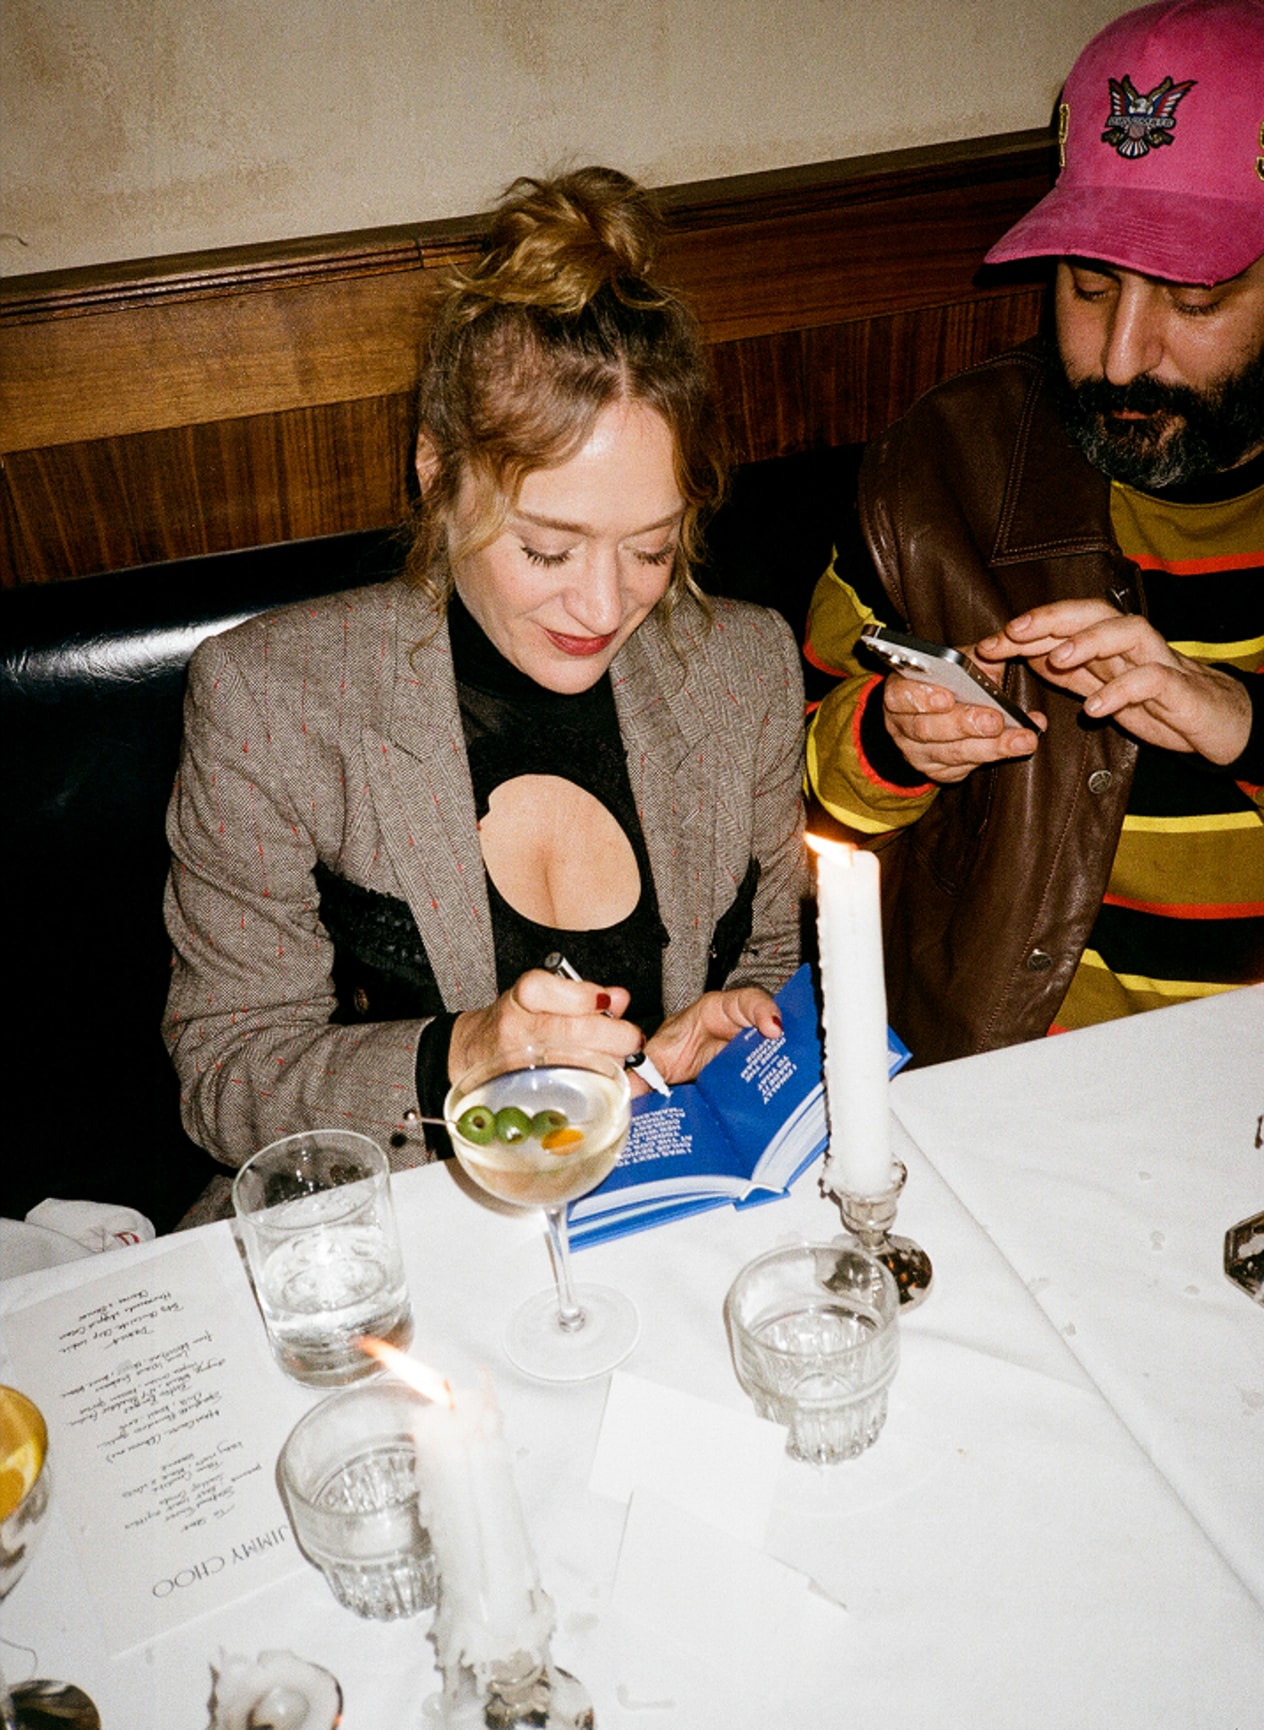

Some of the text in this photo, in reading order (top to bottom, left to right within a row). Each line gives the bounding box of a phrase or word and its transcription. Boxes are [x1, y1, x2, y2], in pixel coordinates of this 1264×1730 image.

[745, 1063, 760, 1082] THE
[758, 1068, 777, 1090] THAT
[769, 1059, 791, 1088] MADE
[632, 1152, 660, 1163] NEXT
[660, 1147, 686, 1157] WAS
[152, 1525, 289, 1598] JIMMY CHOO
